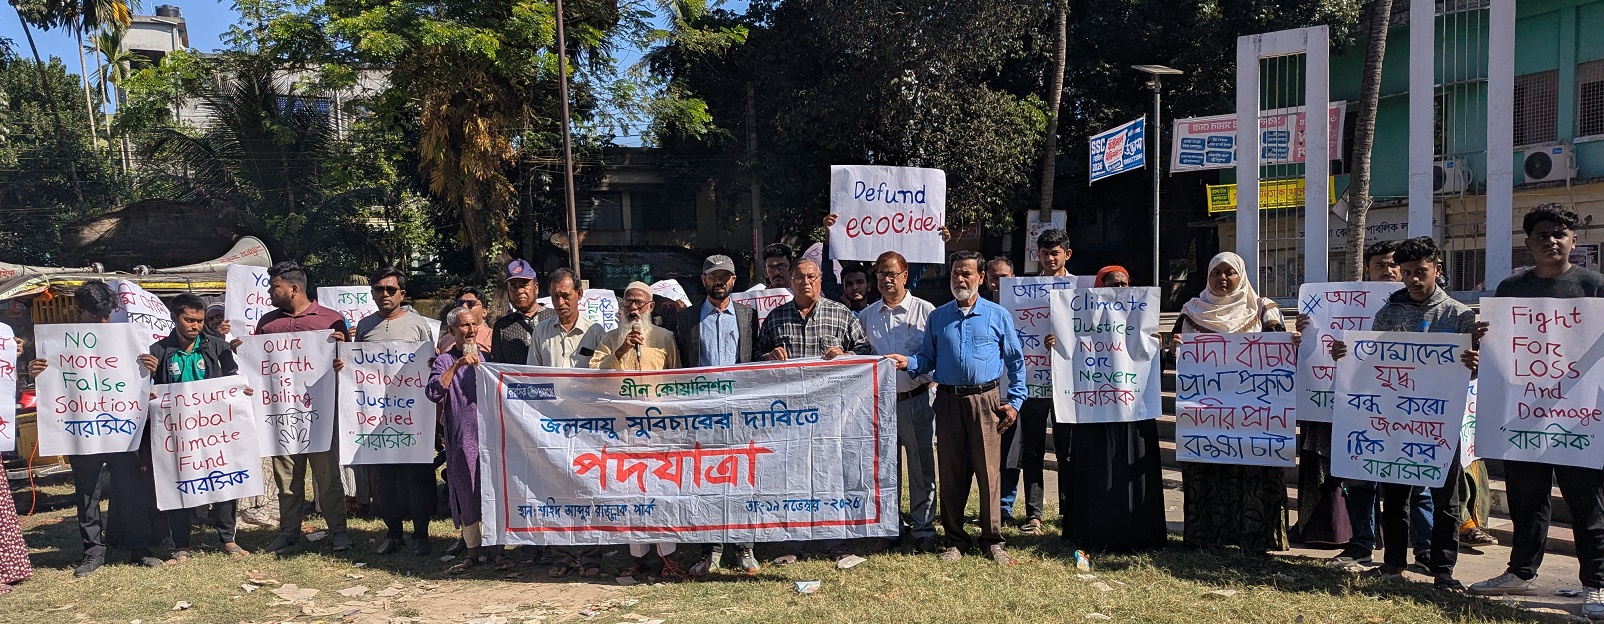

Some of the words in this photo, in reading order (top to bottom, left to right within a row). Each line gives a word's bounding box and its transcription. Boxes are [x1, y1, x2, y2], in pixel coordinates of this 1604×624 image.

[1091, 138, 1105, 155] SSC
[854, 180, 926, 204] Defund
[1365, 221, 1399, 235] পাবলিক
[1070, 292, 1148, 312] Climate
[1071, 317, 1135, 336] Justice
[1511, 306, 1582, 334] Fight
[351, 348, 416, 365] Justice
[1181, 334, 1231, 368] নদী
[1354, 340, 1461, 365] তোমাদের
[261, 356, 314, 376] Earth
[62, 372, 126, 393] False
[280, 376, 291, 387] is
[354, 369, 426, 388] Delayed
[618, 377, 652, 398] গ্রীন
[655, 375, 737, 397] কোয়ালিশন
[1373, 366, 1415, 392] যুদ্ধ
[160, 387, 238, 409] Ensure
[262, 389, 314, 409] Boiling
[354, 390, 415, 408] Justice
[1523, 381, 1568, 400] And
[55, 395, 142, 414] Solution
[1180, 397, 1237, 430] নদীর
[1346, 393, 1382, 414] বন্ধ
[1396, 396, 1450, 416] করো
[1518, 401, 1602, 427] Damage
[163, 404, 232, 432] Global
[356, 410, 413, 426] Denied
[540, 416, 620, 441] জলবায়ু
[625, 406, 733, 440] সুবিচারের
[741, 400, 819, 430] দাবিতে
[165, 430, 240, 453] Climate
[1249, 432, 1294, 461] চাই
[1347, 430, 1385, 455] ঠিক
[179, 450, 229, 471] Fund
[572, 439, 776, 494] পদযাত্রা
[633, 497, 655, 517] পার্ক
[782, 499, 821, 513] নভেম্বর
